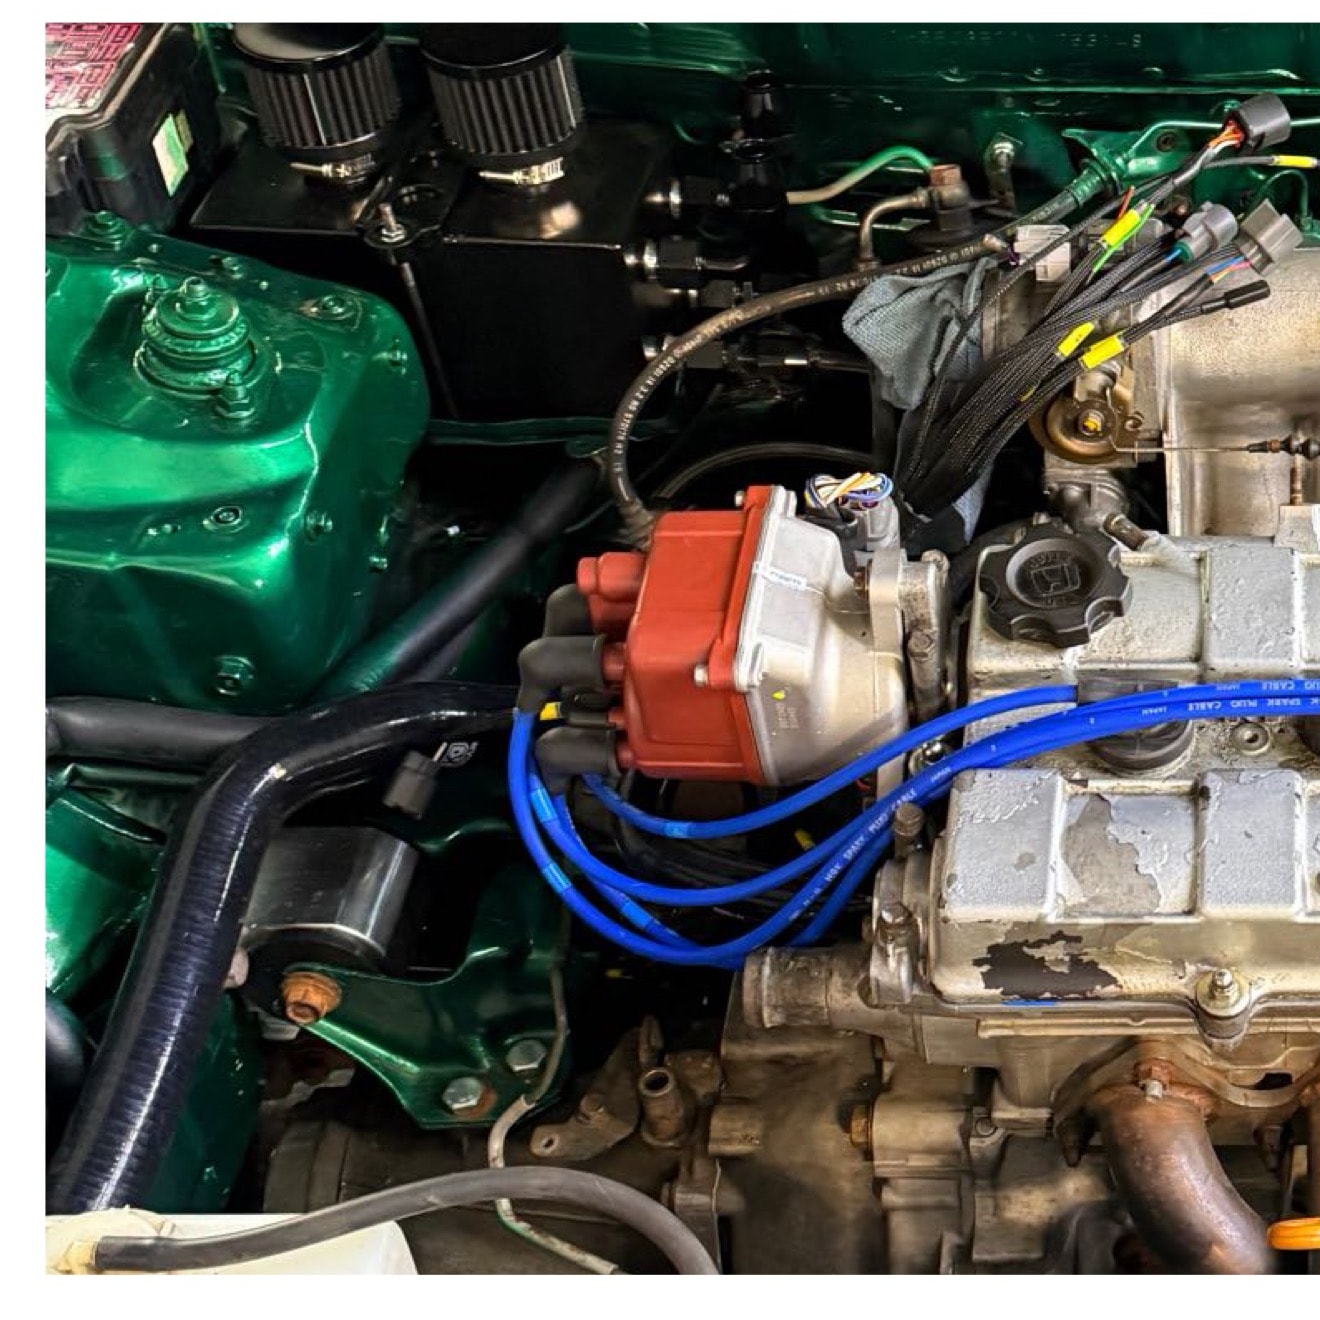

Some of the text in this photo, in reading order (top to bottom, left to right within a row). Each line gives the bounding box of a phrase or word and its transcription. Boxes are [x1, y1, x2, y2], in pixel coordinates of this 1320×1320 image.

[1261, 680, 1295, 690] CABLE
[1188, 701, 1222, 711] CABLE
[1229, 698, 1258, 708] PLUG
[1268, 697, 1301, 708] SPARK
